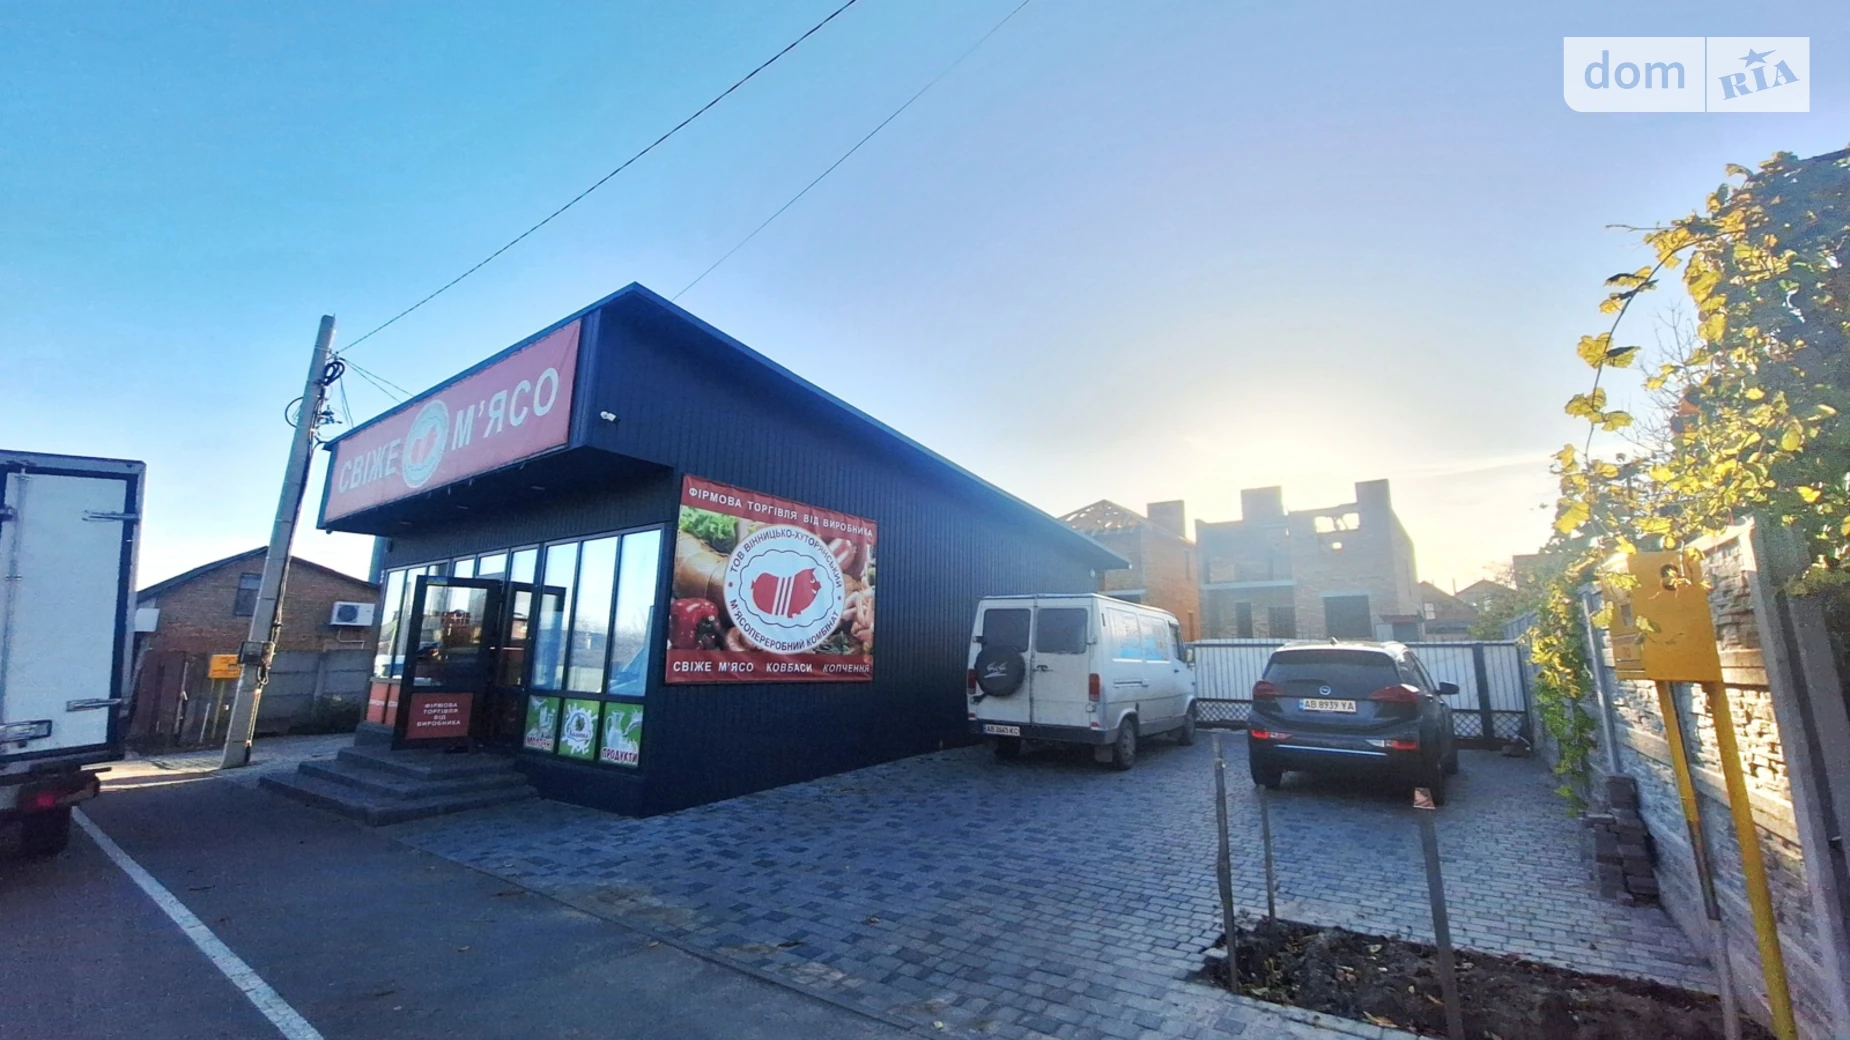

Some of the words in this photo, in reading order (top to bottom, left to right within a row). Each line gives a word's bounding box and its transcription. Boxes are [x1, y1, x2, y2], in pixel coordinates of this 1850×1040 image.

[339, 438, 401, 493] СВІЖЕ
[451, 367, 559, 450] М'ЯСО
[689, 487, 742, 508] ФІРМОВА
[747, 501, 798, 520] ТОРГІВЛЯ
[803, 514, 819, 527] ВІД
[823, 518, 873, 537] ВИРОБНИКА
[730, 551, 745, 573] ТОВ
[730, 599, 805, 651] М'ЯСОПЕРЕРОБНИЙ
[806, 611, 839, 646] КОМБІНАТ
[673, 661, 712, 672] СВІЖЕ
[718, 661, 754, 672] М'ЯСО
[766, 662, 813, 673] КОВБАСИ
[822, 663, 870, 673] КОПЧЕННЯ
[1305, 700, 1316, 708] AB
[1319, 700, 1338, 709] 8939
[1341, 701, 1354, 710] YA
[602, 747, 638, 762] ПРОДУКТИ
